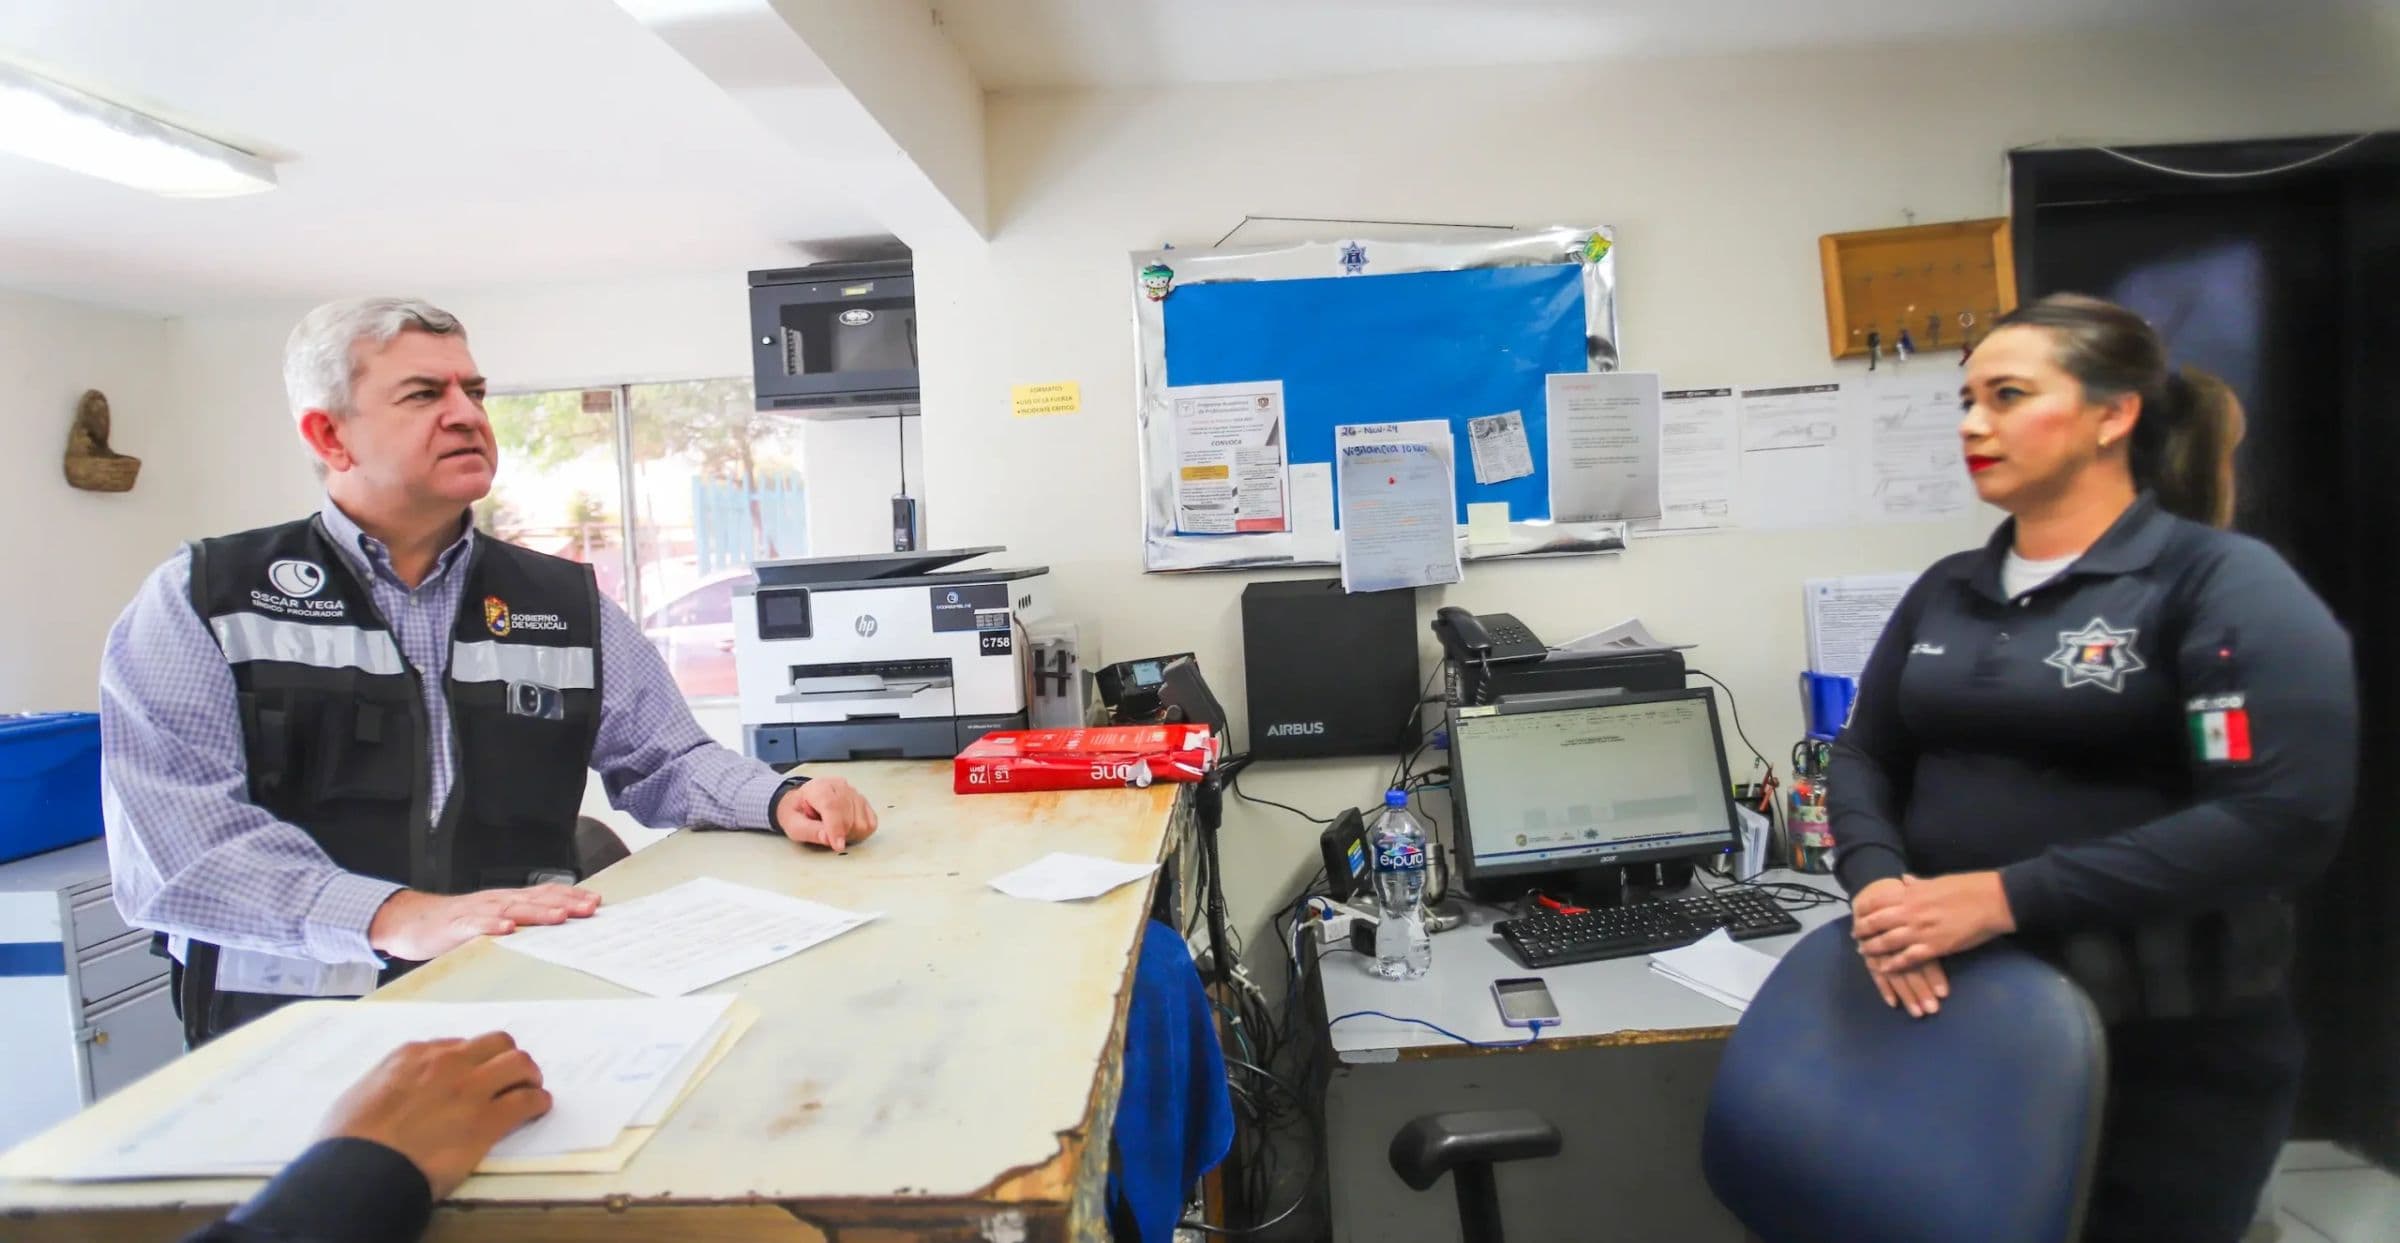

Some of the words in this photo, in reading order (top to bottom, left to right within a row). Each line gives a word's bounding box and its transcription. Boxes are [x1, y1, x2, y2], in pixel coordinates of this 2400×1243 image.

[251, 590, 299, 608] OSCAR
[304, 599, 344, 610] VEGA
[286, 607, 344, 618] PROCURADOR
[511, 613, 559, 622] GOBIERNO
[982, 636, 1010, 648] C758
[1266, 722, 1325, 737] AIRBUS
[969, 772, 986, 784] 70
